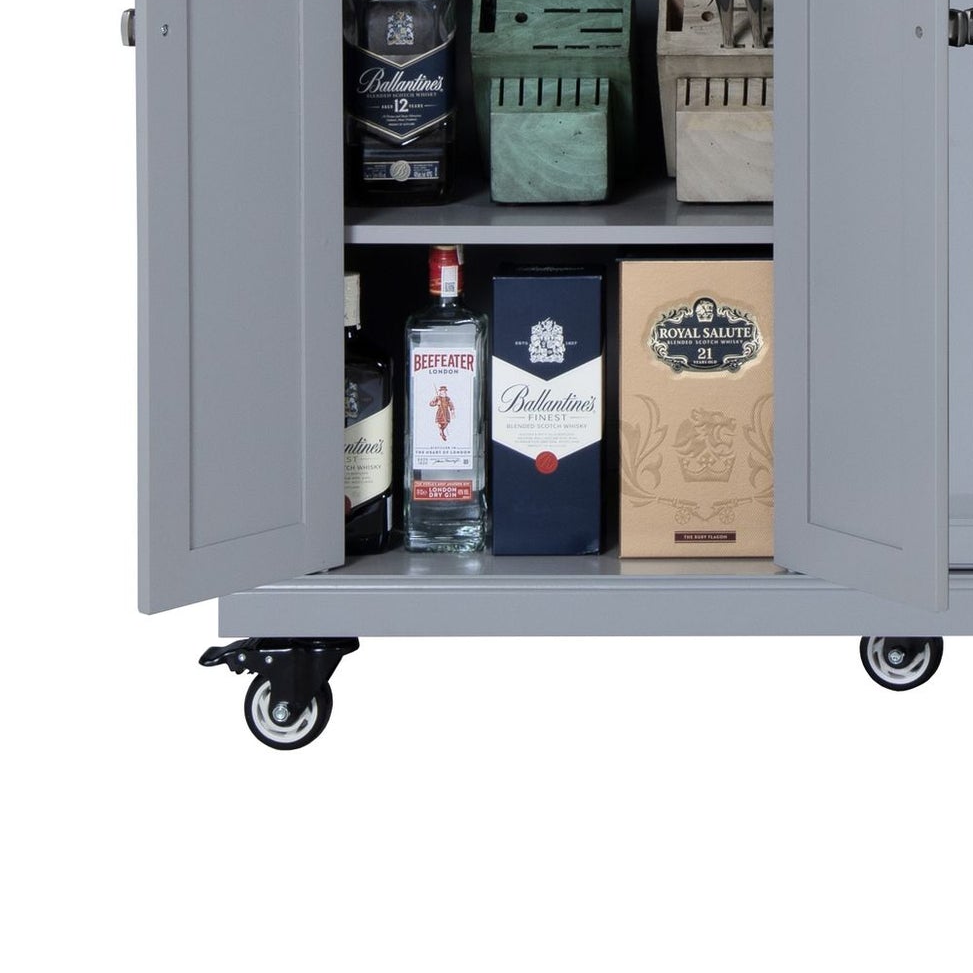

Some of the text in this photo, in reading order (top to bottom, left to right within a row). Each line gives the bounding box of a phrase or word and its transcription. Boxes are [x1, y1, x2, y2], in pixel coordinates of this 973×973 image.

[357, 67, 443, 94] Ballantine's
[394, 98, 409, 113] 12
[659, 327, 752, 339] ROYAL SALUTE
[697, 347, 713, 360] 21
[414, 354, 474, 372] BEEFEATER
[497, 383, 597, 413] Ballantine's
[528, 413, 567, 421] FINEST
